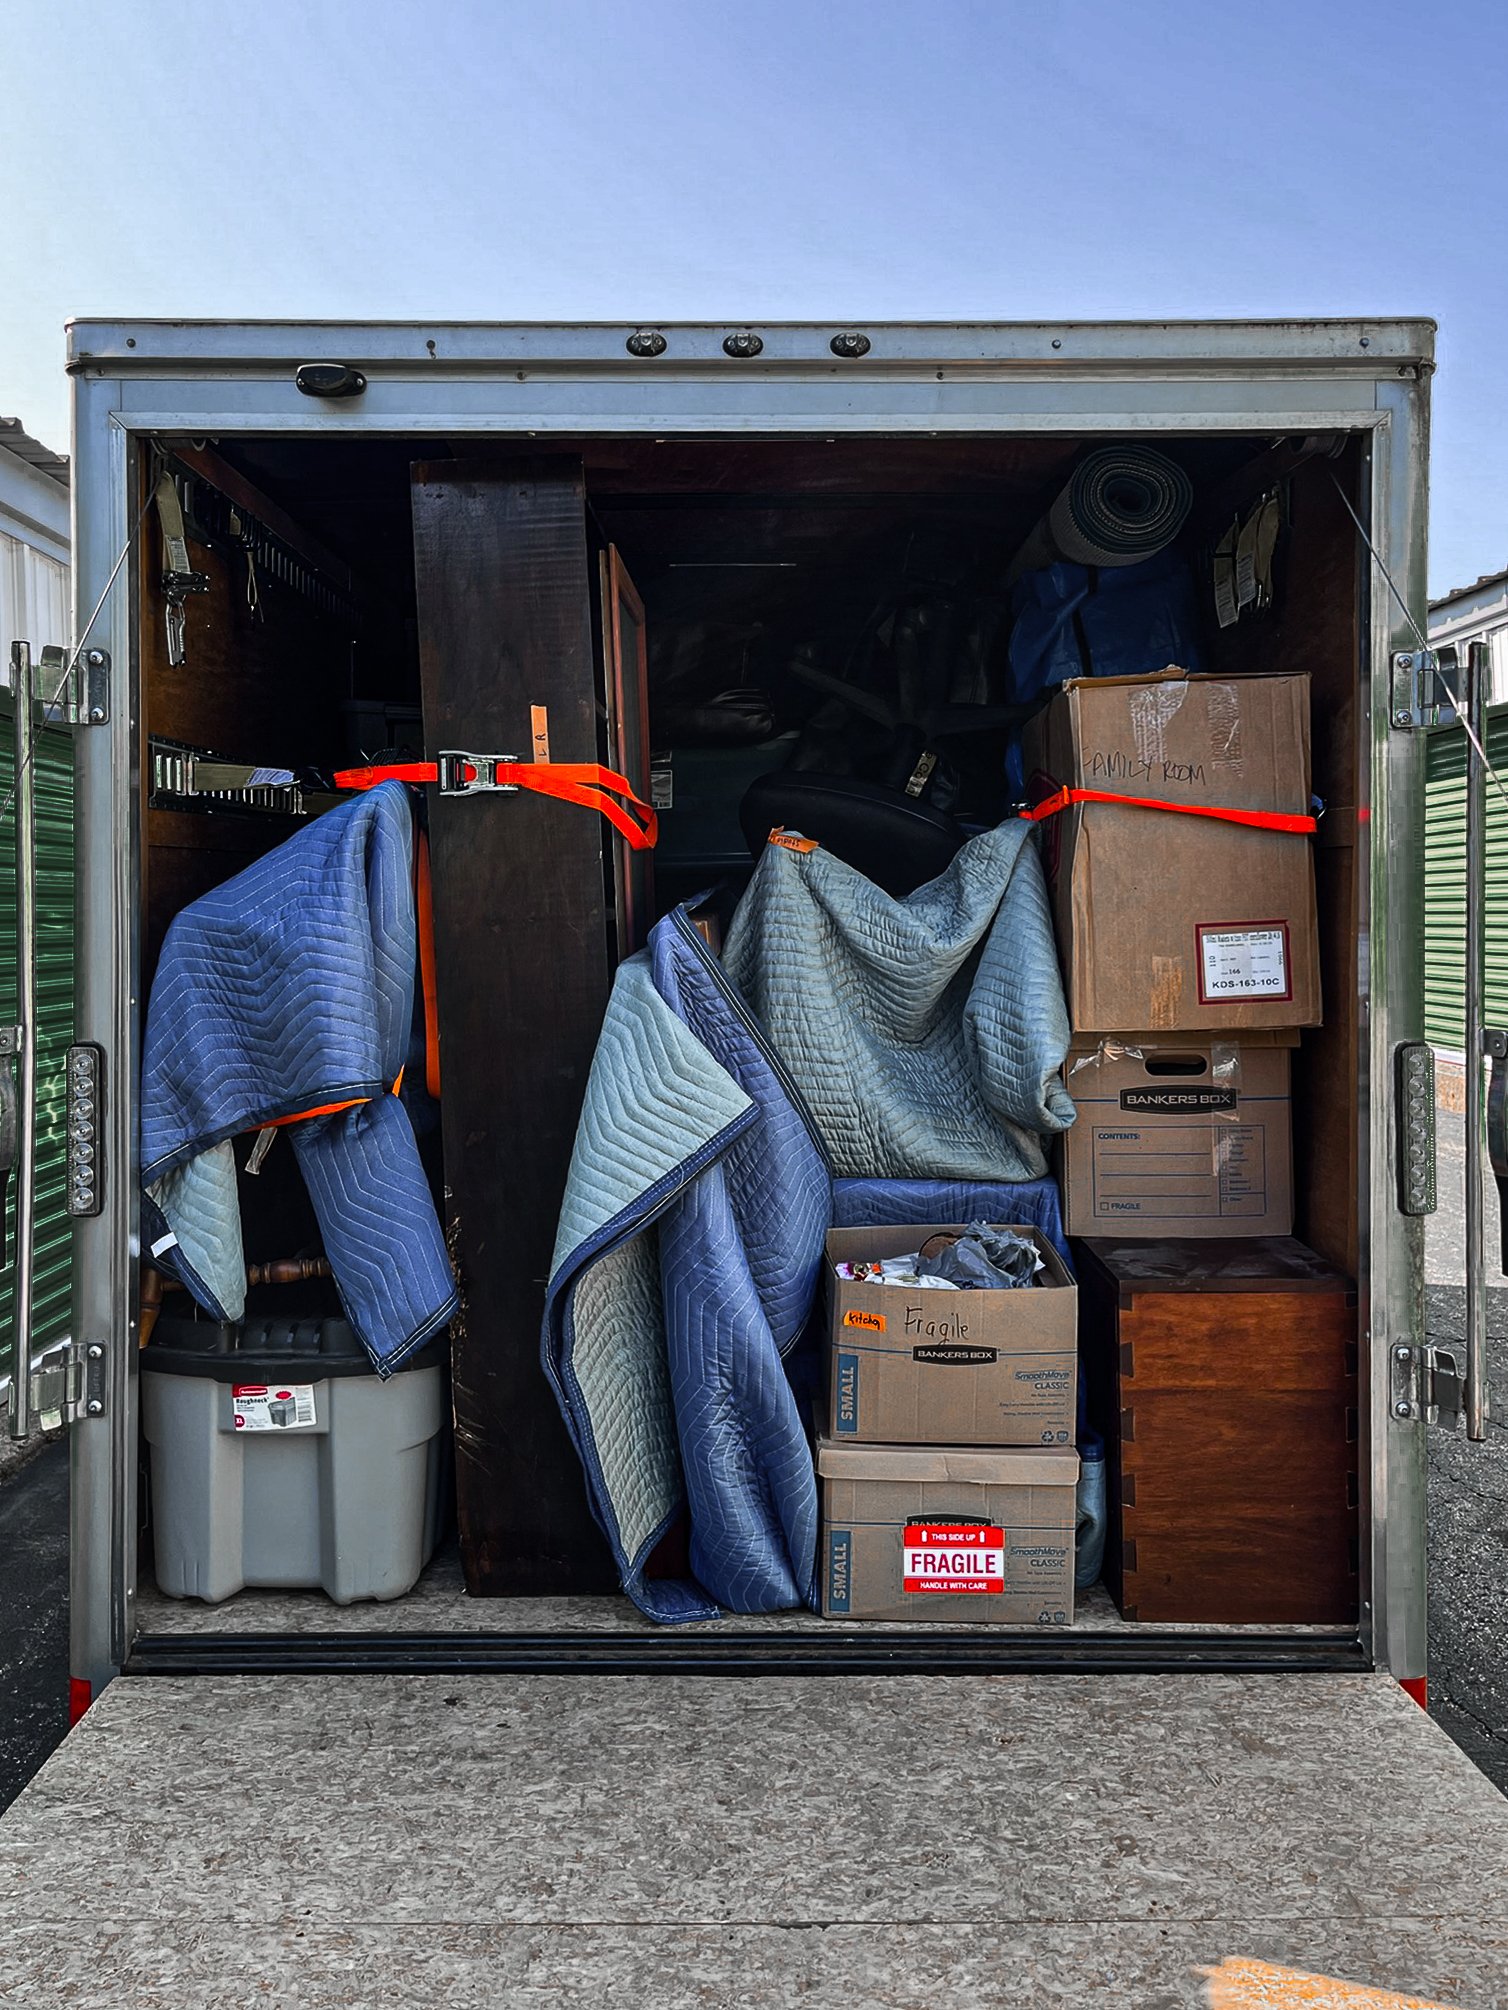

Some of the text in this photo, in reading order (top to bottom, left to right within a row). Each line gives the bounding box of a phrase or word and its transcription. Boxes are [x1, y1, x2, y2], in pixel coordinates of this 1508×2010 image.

[1163, 760, 1206, 785] ROOM
[1212, 978, 1280, 989] KDS-163-10C
[1126, 1094, 1231, 1105] BANKERS BOX
[904, 1306, 970, 1346] Fragile
[917, 1350, 993, 1360] BANKERS BOX
[1034, 1382, 1070, 1390] CLASSIC
[840, 1366, 855, 1421] SMALL
[931, 1533, 948, 1541] THIS
[911, 1553, 996, 1574] FRAGILE
[1030, 1559, 1066, 1567] CLASSIC
[833, 1543, 847, 1600] SMALL
[949, 1582, 967, 1590] WITH
[968, 1582, 988, 1590] CARE
